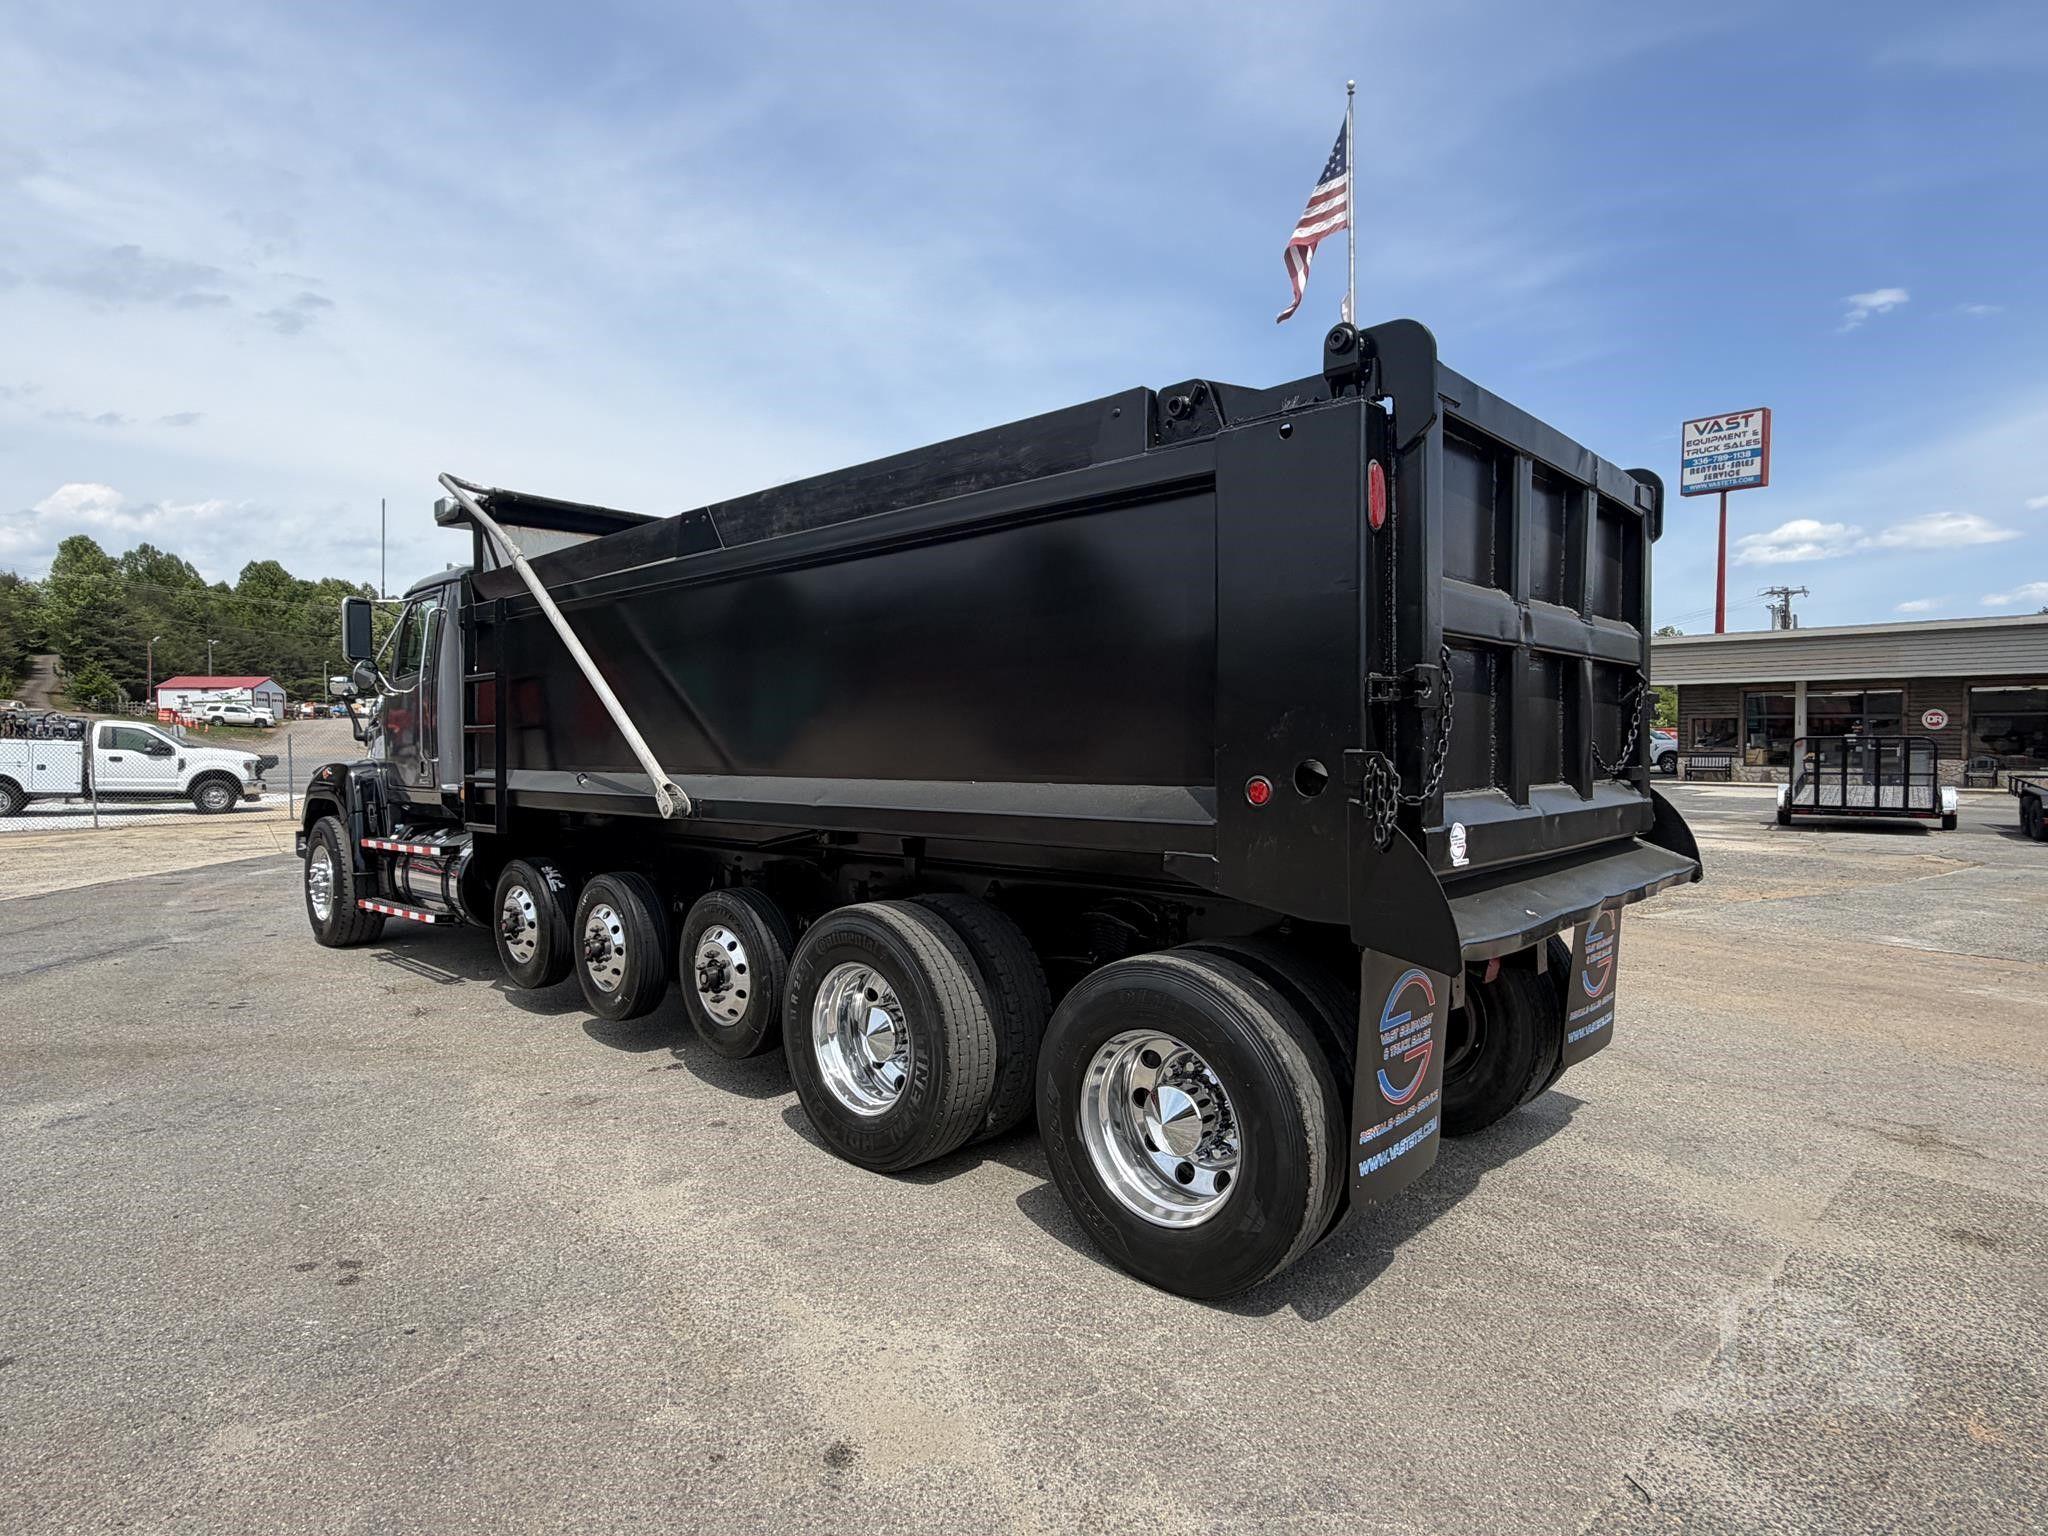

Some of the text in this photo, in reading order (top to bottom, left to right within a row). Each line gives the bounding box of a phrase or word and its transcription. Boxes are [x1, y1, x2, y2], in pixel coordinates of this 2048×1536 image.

[1693, 413, 1755, 436] VAST
[1686, 430, 1748, 447] EQUIPMENT
[1686, 438, 1761, 457] TRUCK SALES
[1703, 469, 1741, 481] SERVICE
